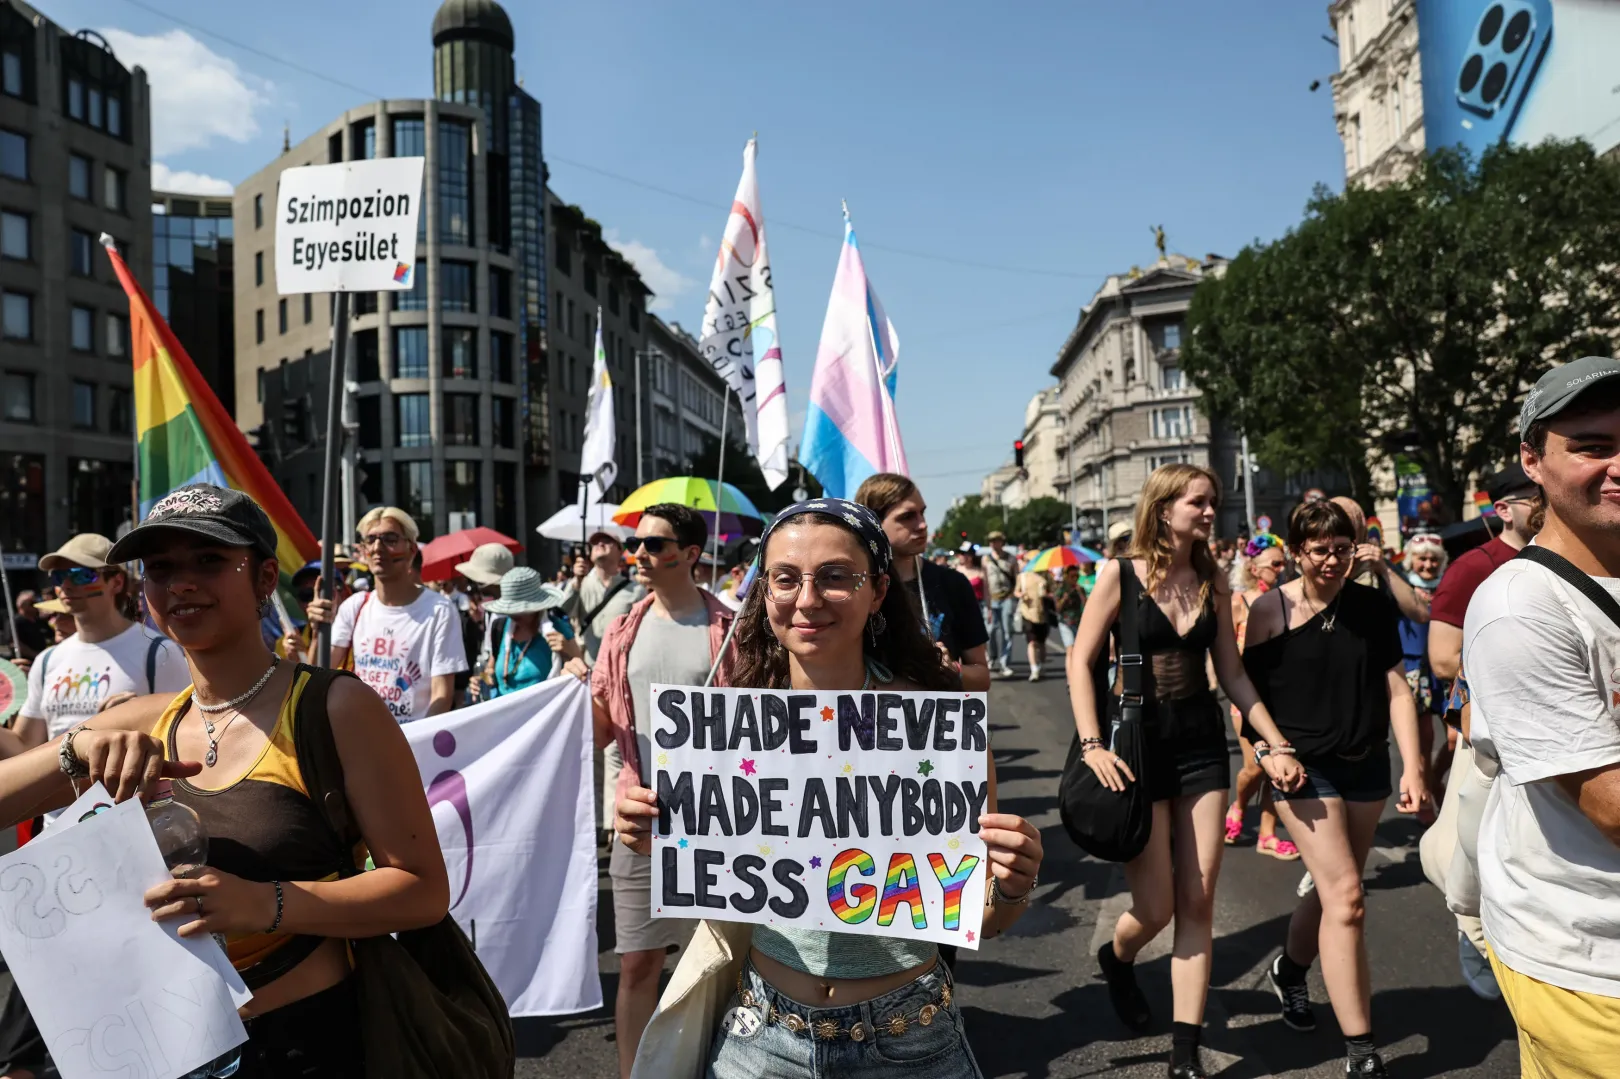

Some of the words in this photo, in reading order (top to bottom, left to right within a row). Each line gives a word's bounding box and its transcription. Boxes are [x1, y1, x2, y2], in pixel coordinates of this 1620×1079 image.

[286, 188, 410, 227] Szimpozion
[293, 231, 398, 271] Egyesület
[370, 657, 400, 671] MEANS
[373, 638, 395, 656] BI
[369, 670, 389, 682] GET
[655, 689, 817, 754] SHADE
[837, 693, 986, 752] NEVER
[657, 770, 789, 837] MADE
[797, 774, 988, 838] ANYBODY
[662, 847, 809, 919] LESS
[827, 848, 979, 931] GAY
